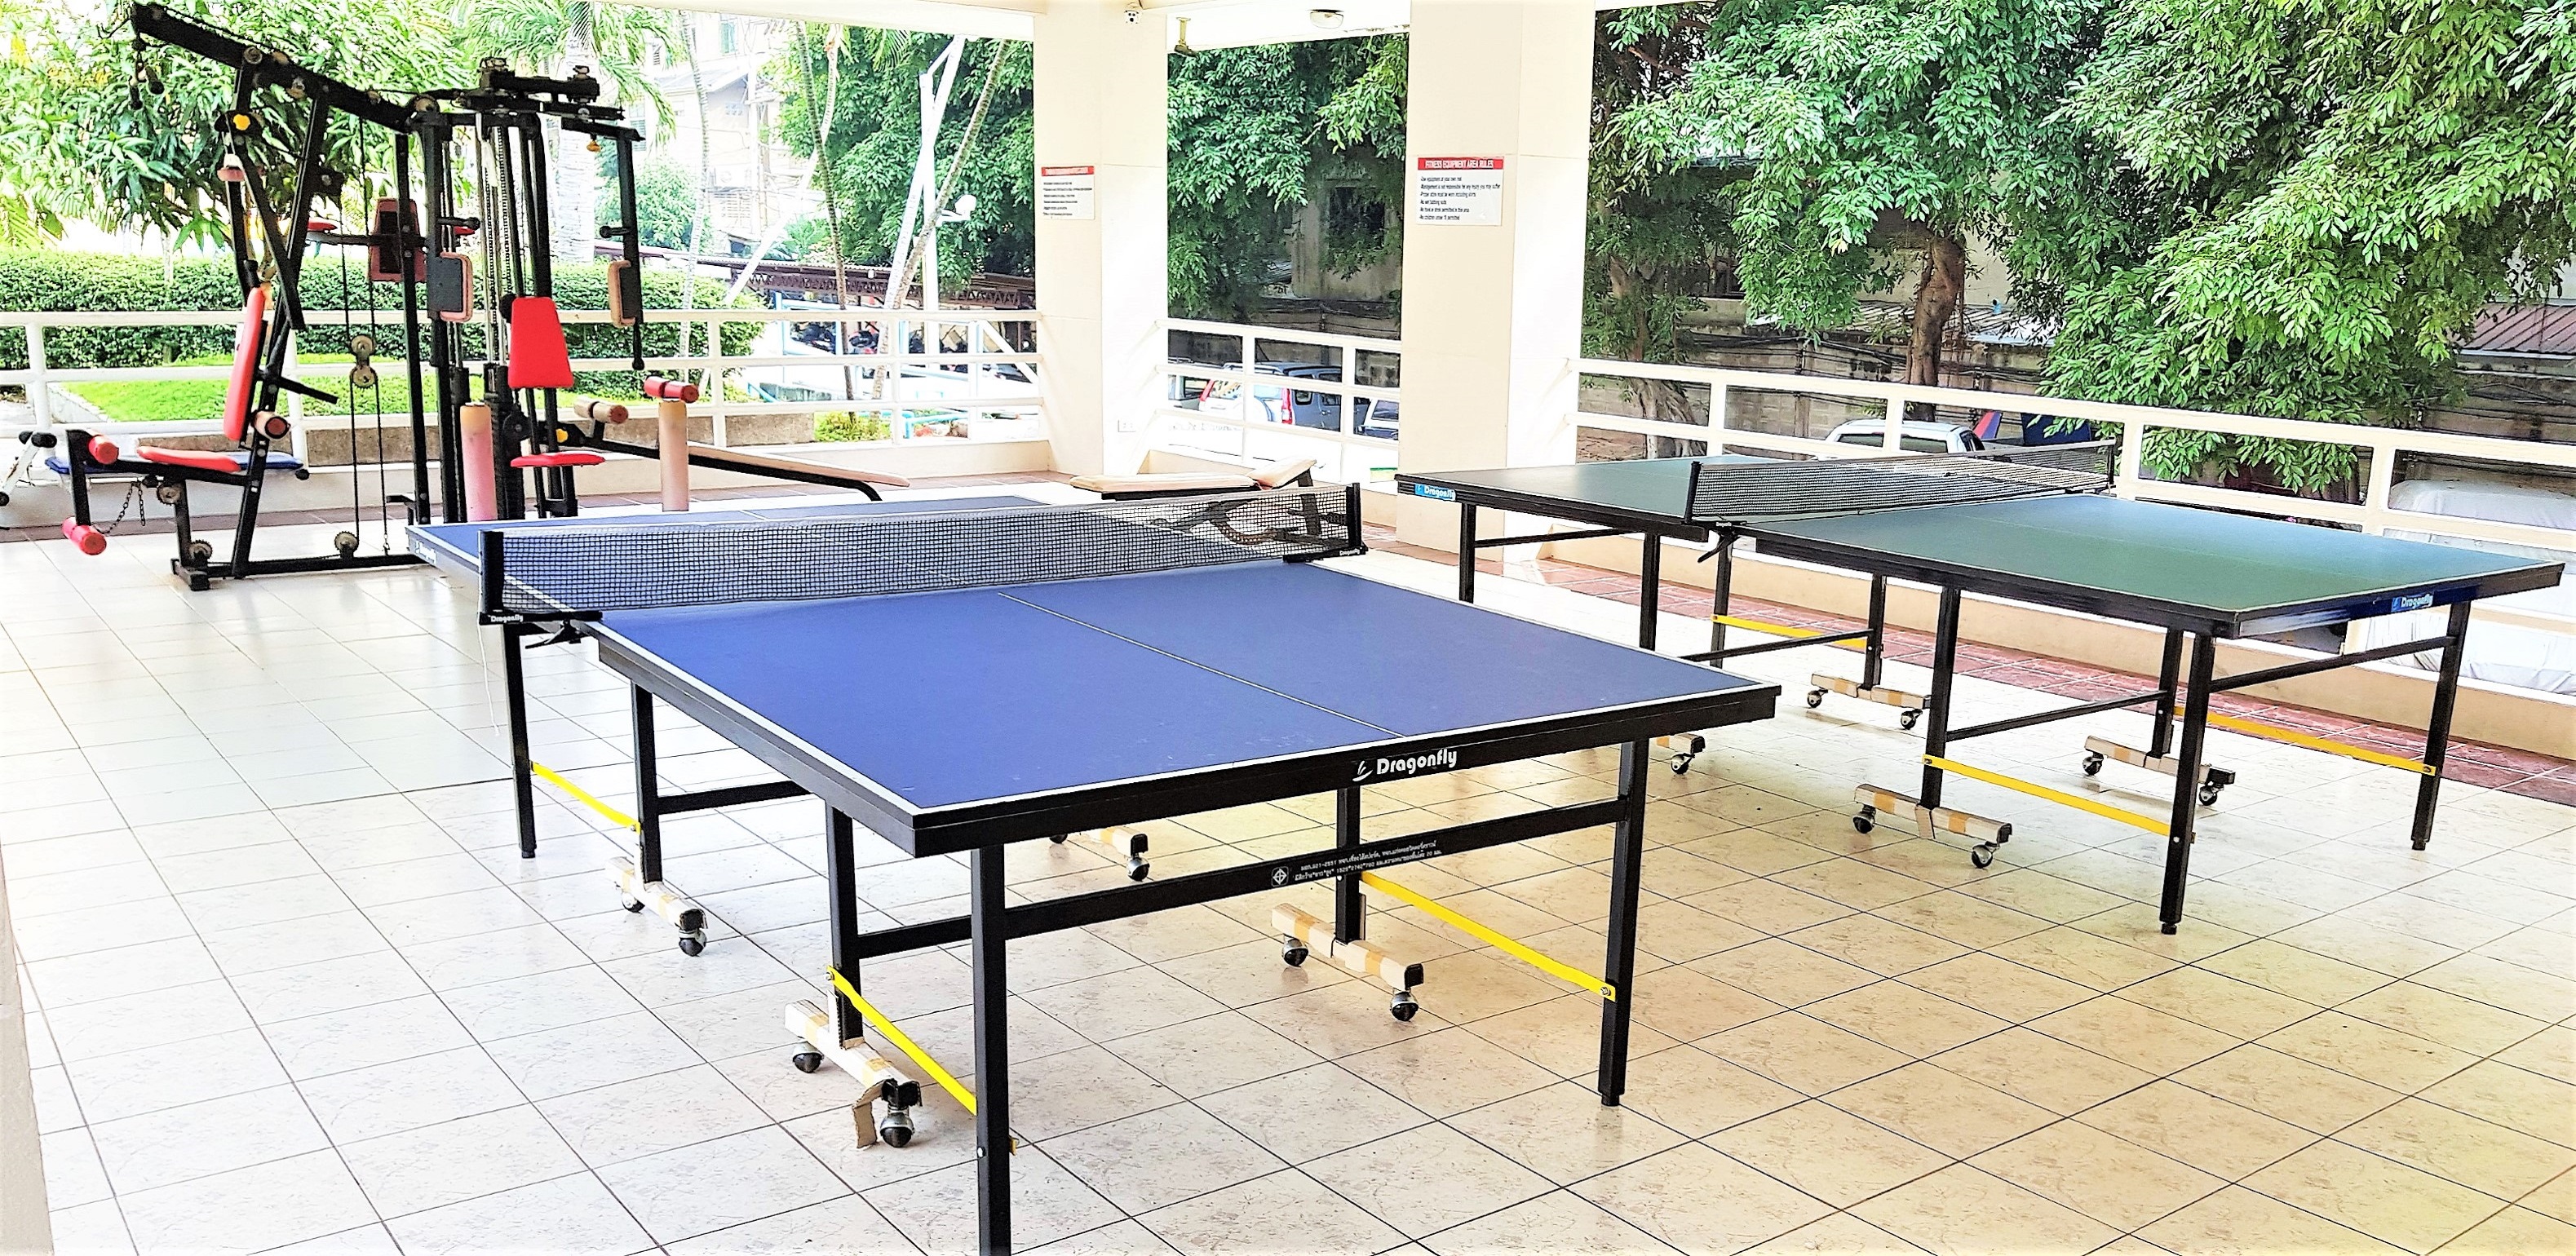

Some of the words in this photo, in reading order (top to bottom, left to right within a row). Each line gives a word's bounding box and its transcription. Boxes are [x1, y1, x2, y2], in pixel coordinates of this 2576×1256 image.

[1424, 485, 1456, 501] Dragonfly
[2401, 594, 2433, 608] Dragonfly
[490, 614, 524, 623] Dragonfly
[1376, 748, 1458, 775] Dragonfly
